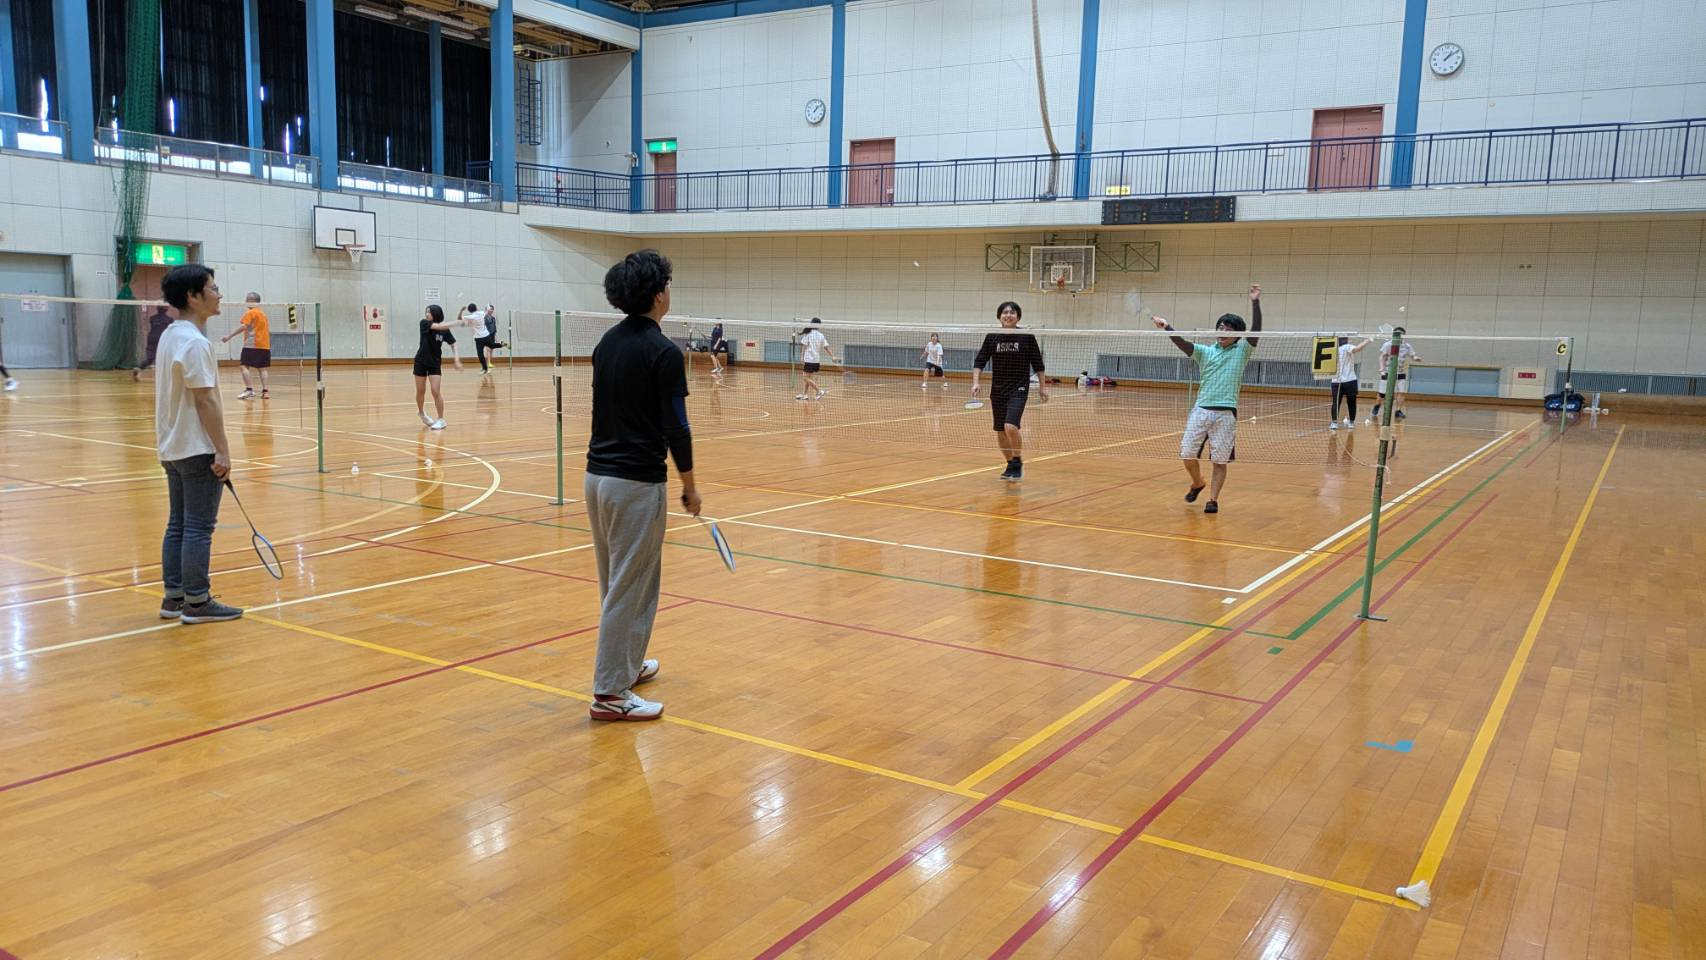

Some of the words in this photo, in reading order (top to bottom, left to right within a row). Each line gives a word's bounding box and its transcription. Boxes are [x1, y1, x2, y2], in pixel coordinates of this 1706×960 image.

[288, 306, 296, 324] E
[1314, 341, 1335, 369] F
[1557, 343, 1566, 354] C
